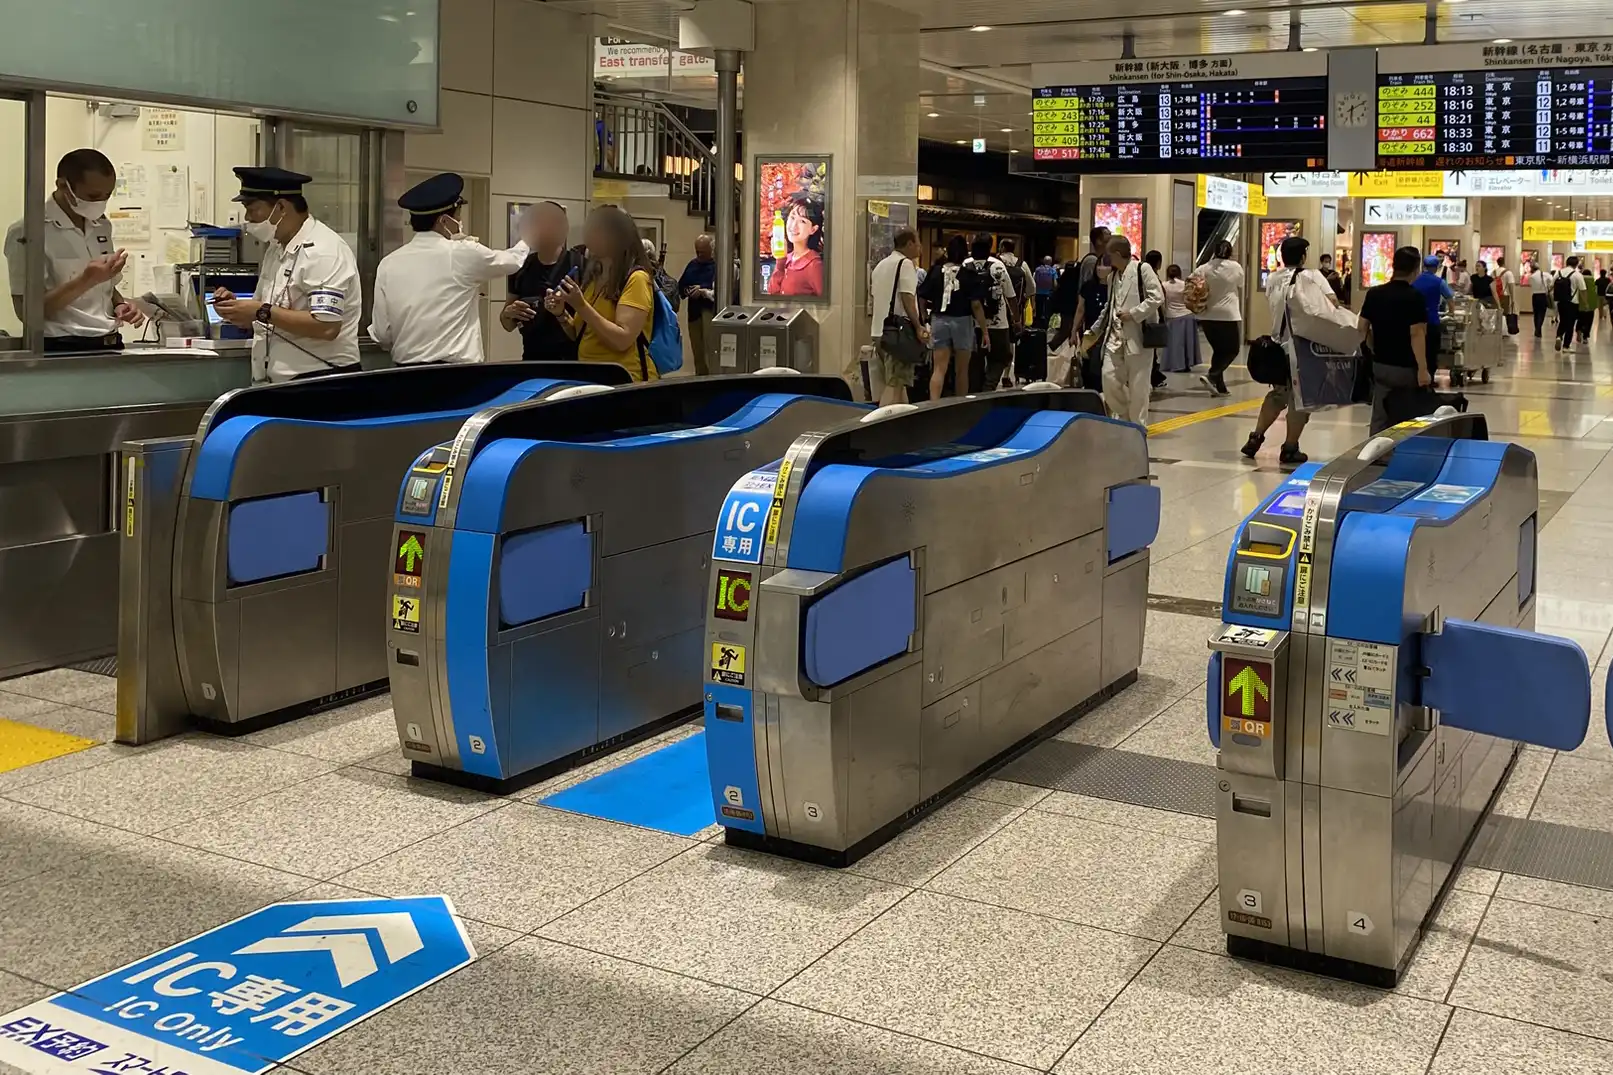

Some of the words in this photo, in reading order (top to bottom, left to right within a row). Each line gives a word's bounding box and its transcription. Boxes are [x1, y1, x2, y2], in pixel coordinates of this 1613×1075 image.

[600, 57, 624, 67] East
[1538, 56, 1553, 64] (for
[1556, 55, 1593, 64] Nagoya,
[1166, 71, 1208, 79] Shin-Osaka,
[1209, 69, 1238, 77] Hakata)
[1414, 88, 1433, 96] 444
[1444, 86, 1473, 96] 18:13
[1485, 82, 1511, 91] 東京
[1538, 83, 1550, 93] 11
[1556, 84, 1567, 92] 1,2
[1569, 83, 1585, 91] 号車
[1064, 99, 1075, 107] 75
[1118, 95, 1139, 103] 広島
[1160, 95, 1169, 104] 13
[1414, 101, 1433, 110] 252
[1443, 100, 1473, 110] 18:16
[1485, 97, 1511, 105] 東京
[1538, 98, 1550, 107] 12
[1556, 98, 1567, 106] 1,2
[1569, 97, 1584, 105] 号車
[1061, 112, 1077, 120] 243
[1160, 109, 1169, 117] 13
[1417, 116, 1430, 124] 44
[1443, 115, 1472, 124] 18:21
[1485, 111, 1511, 120] 東京
[1538, 112, 1549, 122] 11
[1556, 113, 1567, 121] 1,2
[1569, 112, 1584, 120] 号車
[1118, 121, 1138, 129] 博多
[1160, 122, 1170, 130] 14
[1413, 129, 1433, 139] 662
[1443, 129, 1473, 138] 18:33
[1485, 125, 1511, 134] 東京
[1538, 127, 1549, 136] 12
[1555, 127, 1567, 135] 1-5
[1568, 126, 1584, 134] 号車
[1062, 137, 1078, 145] 409
[1160, 135, 1169, 143] 13
[1414, 143, 1433, 152] 254
[1443, 143, 1473, 152] 18:30
[1484, 140, 1511, 149] 東京
[1538, 141, 1549, 151] 11
[1555, 142, 1566, 150] 1,2
[1568, 141, 1583, 149] 号車
[1062, 149, 1078, 158] 517
[1160, 147, 1170, 156] 14
[726, 500, 760, 532] IC
[722, 535, 753, 556] 専用
[717, 576, 751, 612] IC
[1244, 721, 1265, 735] QR
[473, 740, 482, 750] 2
[729, 790, 739, 801] 2
[807, 806, 818, 818] 3
[1244, 894, 1257, 907] 3
[1353, 917, 1366, 930] 4
[123, 952, 356, 1036] IC専用
[103, 996, 159, 1019] IC
[154, 1012, 245, 1051] Only
